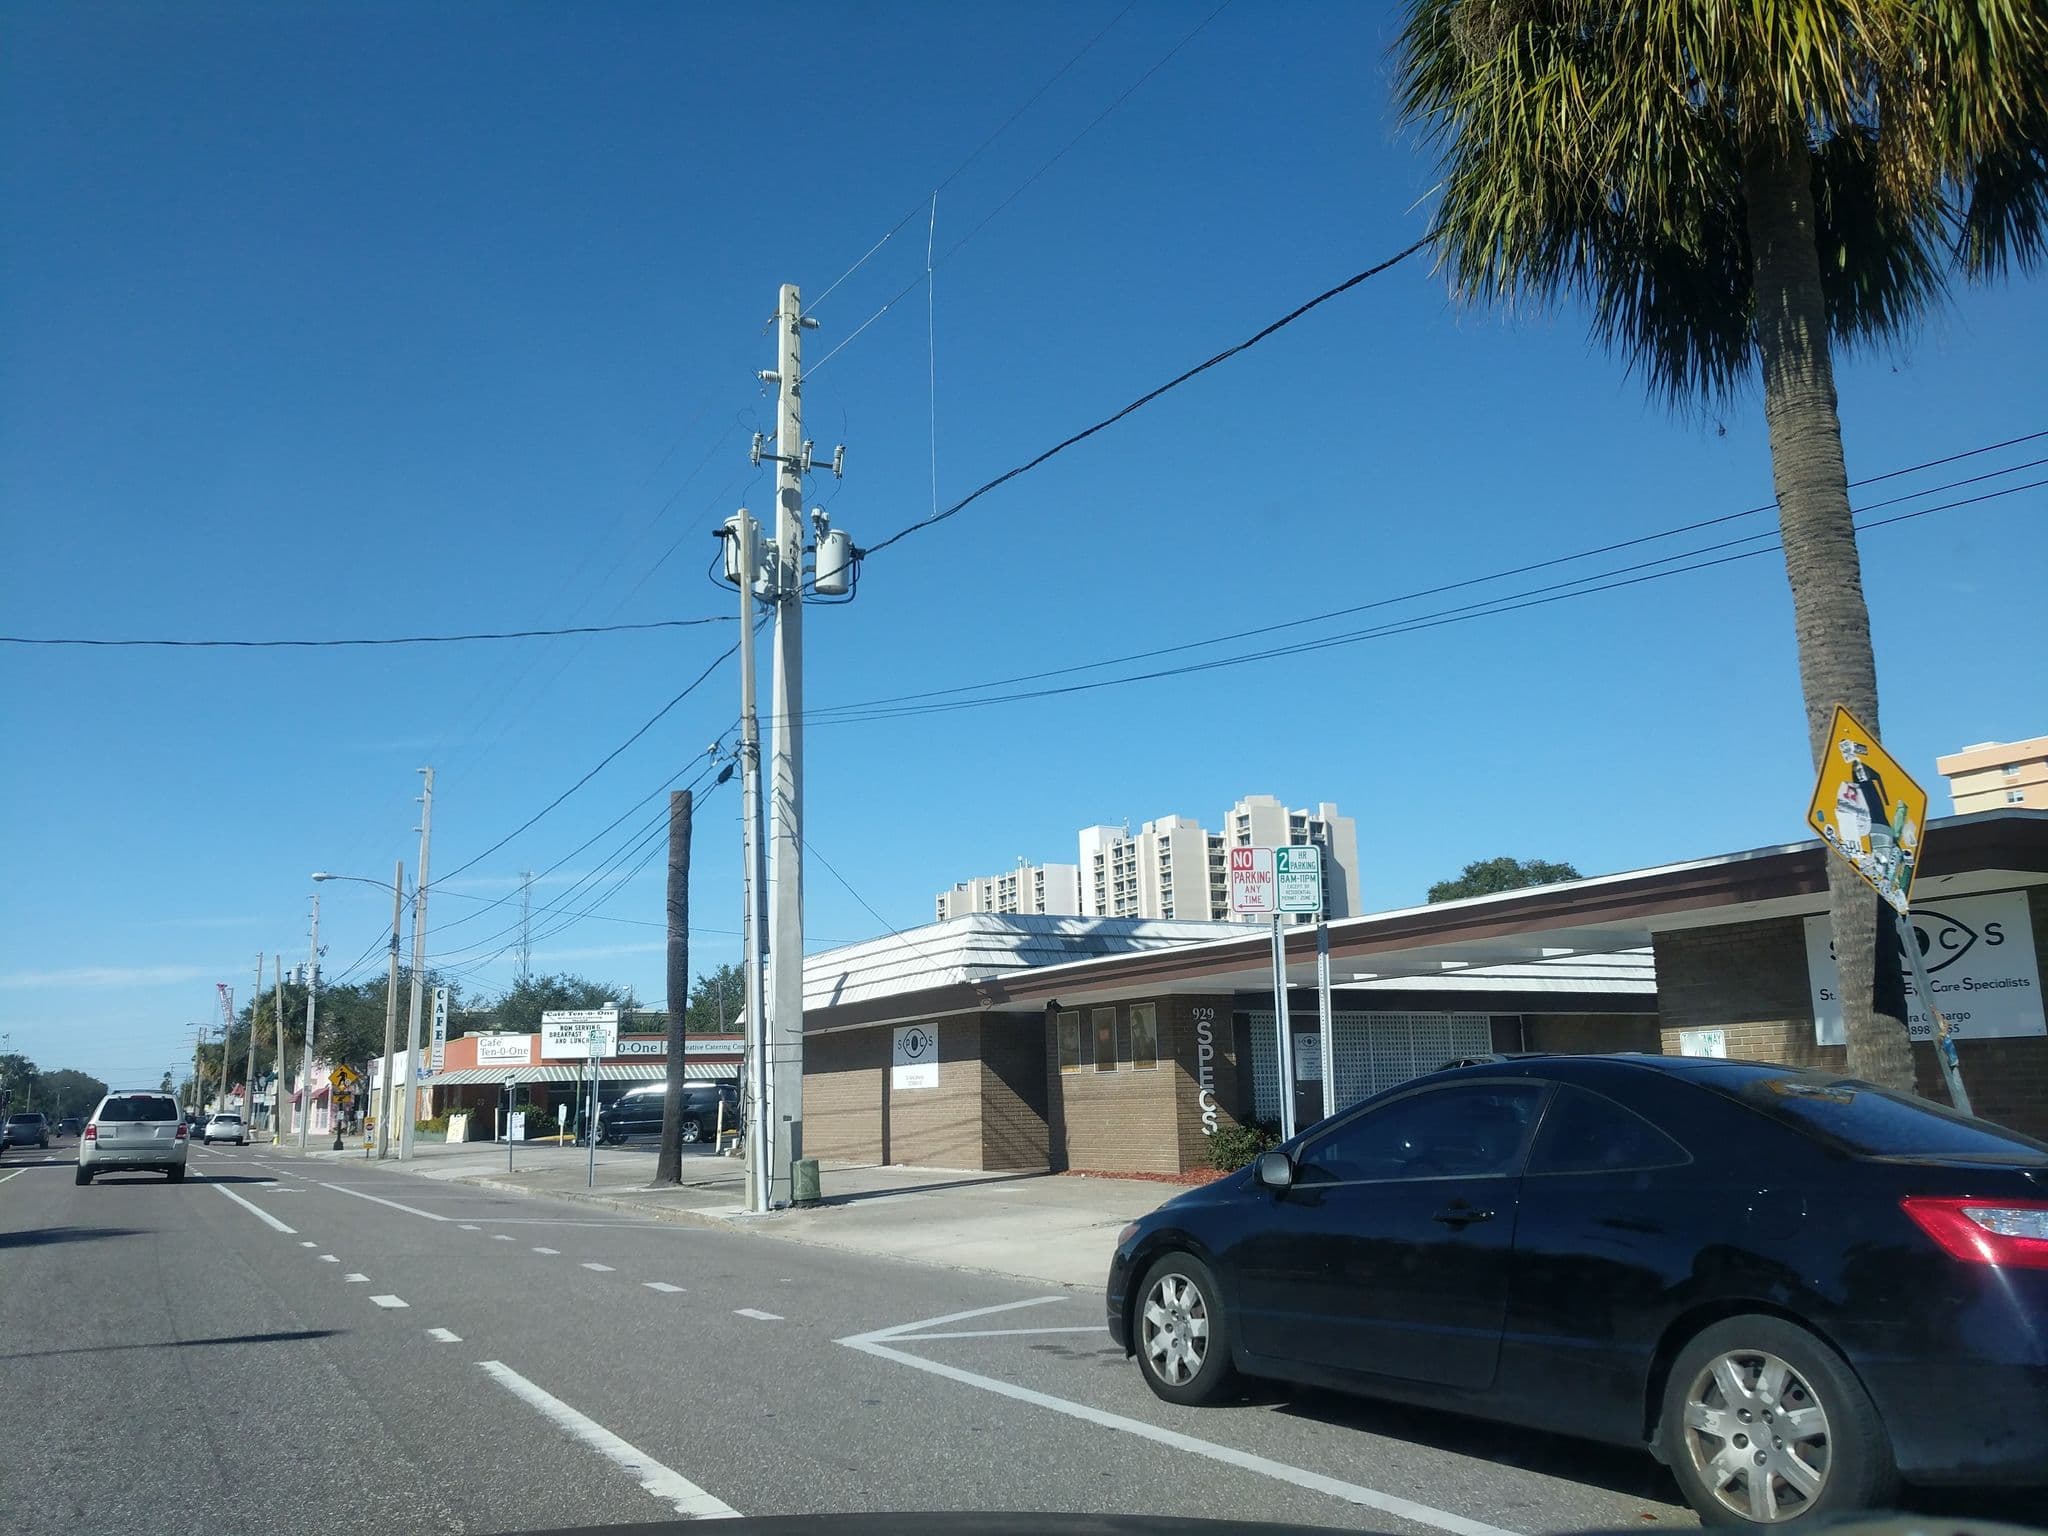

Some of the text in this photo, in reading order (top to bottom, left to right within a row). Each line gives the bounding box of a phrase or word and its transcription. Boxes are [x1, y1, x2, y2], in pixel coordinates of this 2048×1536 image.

[1233, 851, 1252, 868] NO
[1278, 851, 1307, 871] 2 HR
[1290, 862, 1316, 870] PARKING
[1234, 871, 1271, 884] PARKING
[1245, 885, 1261, 893] ANY
[1244, 895, 1262, 904] TIME
[1930, 980, 1960, 993] Care
[1962, 977, 2031, 992] Specialists
[436, 989, 445, 1040] CAFE
[1192, 1007, 1215, 1020] 929
[705, 1043, 730, 1051] Catering
[1197, 1021, 1218, 1136] SPECS
